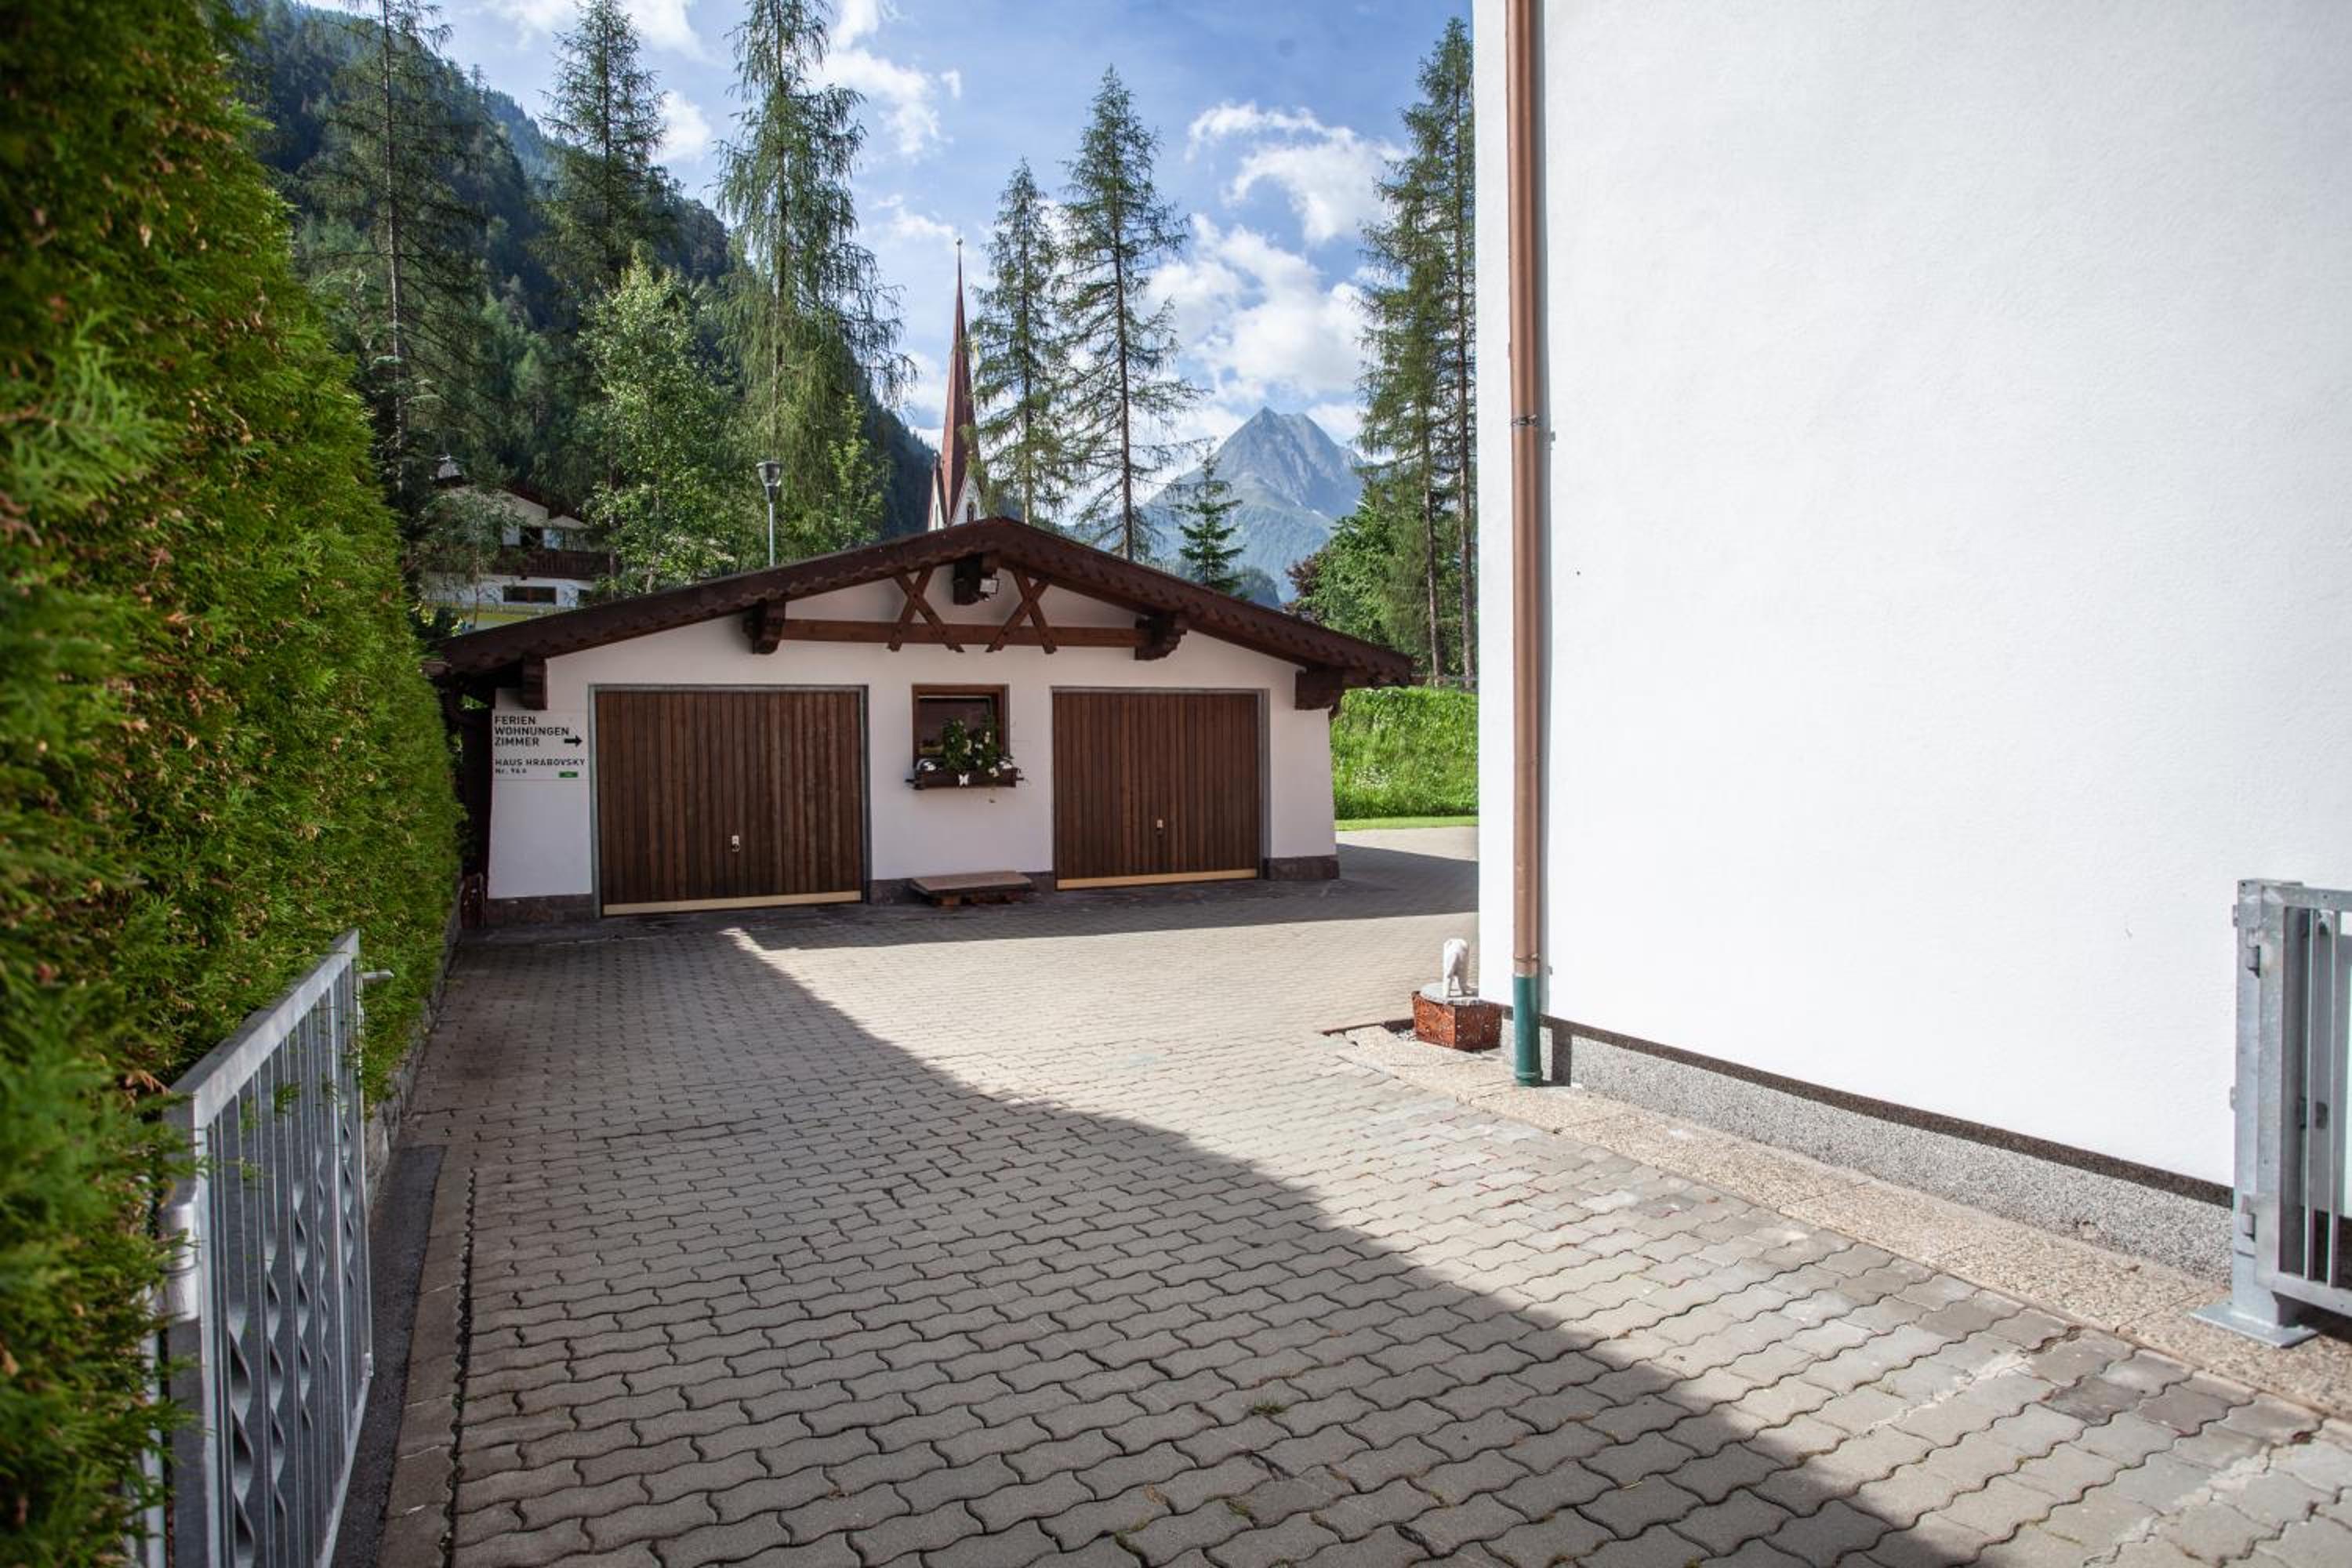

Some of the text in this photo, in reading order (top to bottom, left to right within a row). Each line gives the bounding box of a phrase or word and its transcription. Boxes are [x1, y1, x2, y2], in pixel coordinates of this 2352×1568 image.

[495, 716, 535, 724] FERIEN
[495, 727, 569, 735] WOHNUNGEN
[495, 737, 539, 746] ZIMMER
